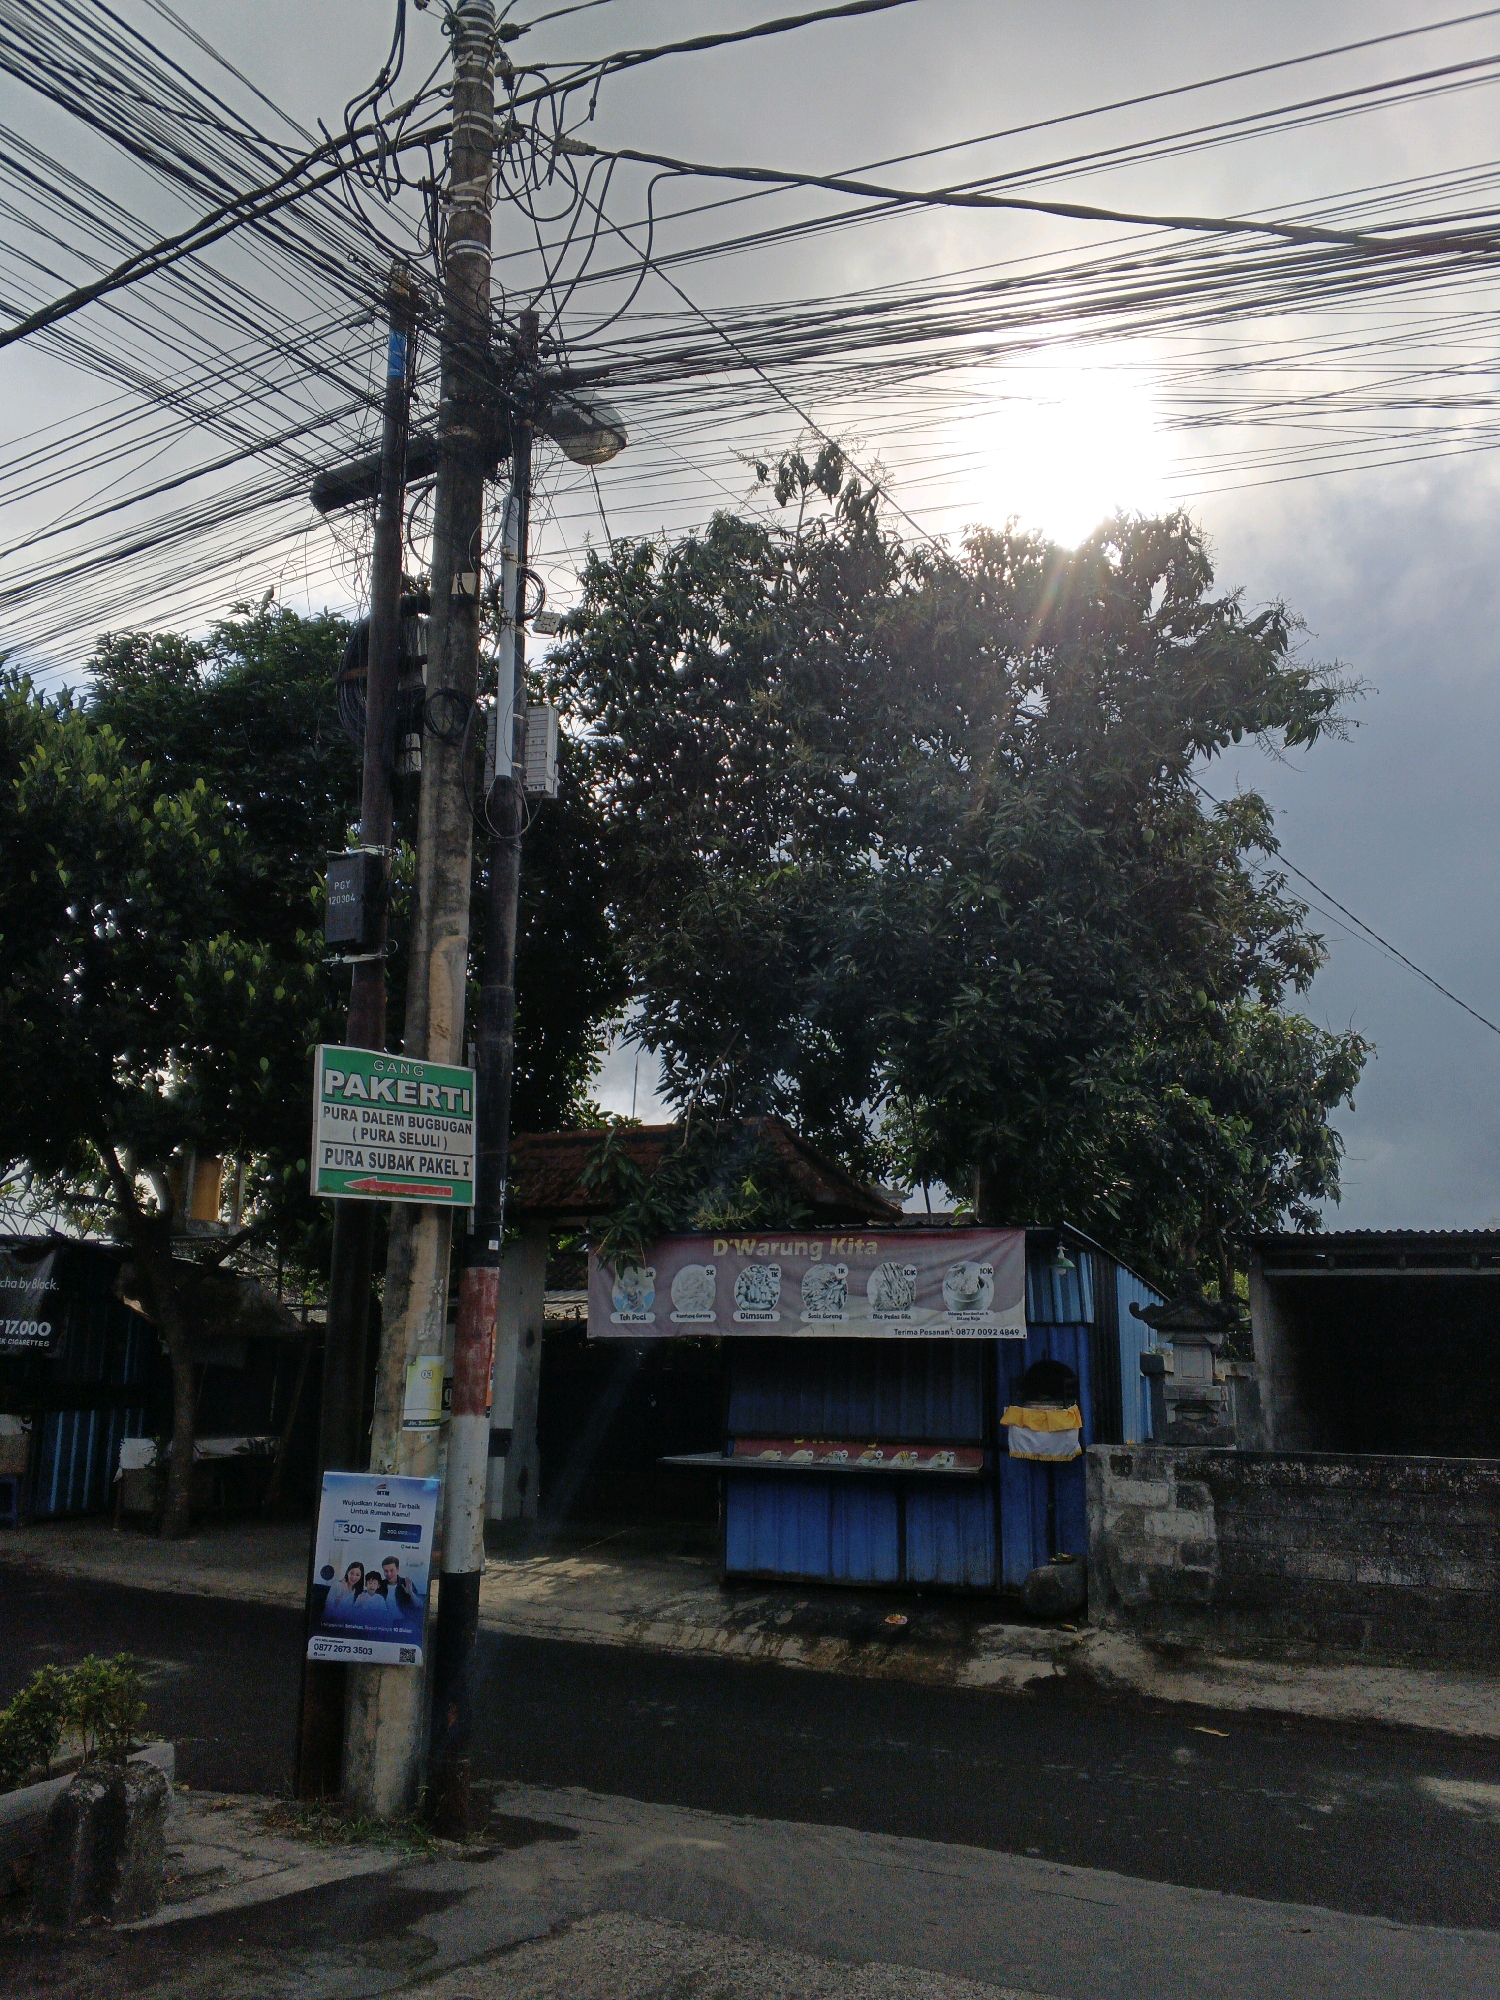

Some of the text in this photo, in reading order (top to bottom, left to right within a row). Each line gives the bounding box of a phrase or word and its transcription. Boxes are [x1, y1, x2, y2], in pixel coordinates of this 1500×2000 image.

[335, 880, 350, 890] PGY
[329, 894, 355, 905] 120304
[374, 1060, 424, 1077] GANG
[324, 1069, 472, 1114] PAKERTI
[323, 1106, 472, 1135] PURA DALEM BUGBUGAN
[361, 1127, 395, 1143] PURA
[399, 1132, 440, 1148] SELULI
[325, 1148, 469, 1176] PURA SUBAK PAKEL I
[713, 1238, 878, 1261] D'Warung Kita
[979, 1267, 993, 1275] 10K
[19, 1276, 32, 1292] by
[740, 1312, 773, 1320] Dimsum
[894, 1328, 918, 1336] Terima
[919, 1328, 950, 1336] Pesanan
[956, 1328, 976, 1336] 0877
[977, 1328, 998, 1336] 0092
[999, 1328, 1020, 1336] 4849
[8, 1338, 50, 1347] CIGARETTES
[342, 1500, 421, 1510] Wujudkan Koneksi Terbaik
[343, 1523, 365, 1535] 300
[313, 1643, 373, 1655] 0877 2673 3503
